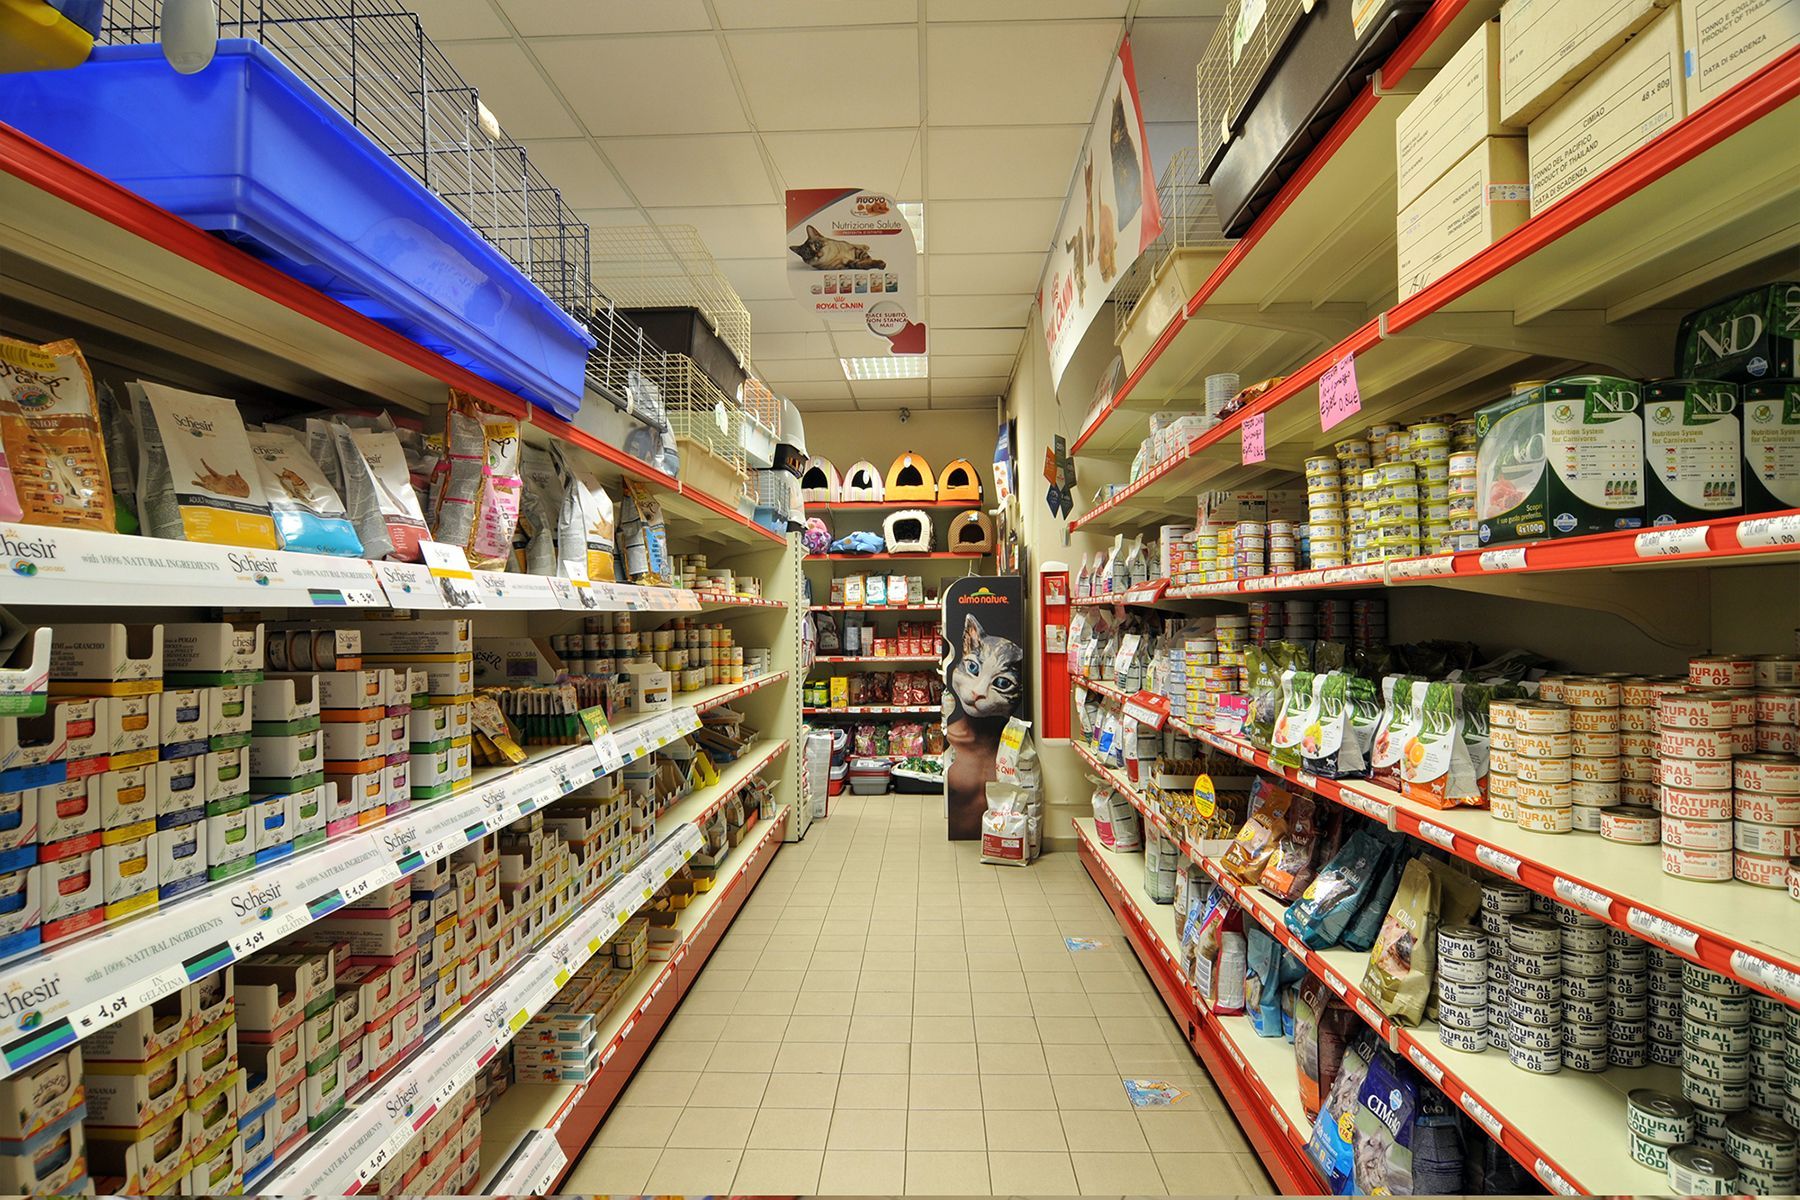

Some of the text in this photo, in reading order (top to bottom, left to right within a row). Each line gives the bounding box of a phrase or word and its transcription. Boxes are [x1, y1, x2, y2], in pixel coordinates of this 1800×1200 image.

[1701, 17, 1724, 36] TONNO
[1701, 14, 1743, 45] PRODUCT OF
[1703, 34, 1767, 76] DATA DI SCADENZA
[1583, 107, 1605, 128] CIMIAO
[1533, 133, 1592, 180] TONNO DEL PACIFICO
[1534, 140, 1599, 190] PRODUCT OF THAILAND
[1534, 166, 1588, 207] DATA DI SCADENZA
[832, 220, 901, 229] Nutrizione Salute
[816, 302, 864, 310] ROYAL CANIN
[1695, 313, 1762, 365] N&D
[1592, 391, 1639, 413] N&D
[1692, 392, 1737, 414] N&D
[172, 413, 214, 432] Schesir
[1552, 428, 1604, 436] Nutrition System
[1526, 504, 1543, 513] Scopri
[1517, 522, 1545, 535] 4x100g
[82, 554, 99, 564] with
[101, 555, 121, 566] 100%
[123, 556, 166, 568] NATURAL
[167, 558, 220, 571] INGREDIENTS
[227, 552, 278, 574] Schesir
[384, 566, 417, 584] Schesir
[481, 574, 506, 589] Schesir
[338, 633, 359, 643] Schesir
[1712, 677, 1730, 685] 02
[1689, 717, 1709, 726] 03
[1539, 748, 1552, 756] 01
[1697, 748, 1716, 758] 03
[1526, 771, 1537, 780] 01
[1674, 776, 1692, 786] 03
[1744, 780, 1762, 790] 03
[1540, 797, 1552, 805] 01
[1668, 793, 1731, 809] NATURAL
[1670, 805, 1709, 817] CODE
[1753, 811, 1774, 822] 03
[1544, 822, 1556, 830] 01
[1667, 834, 1682, 844] 03
[1667, 863, 1681, 873] 03
[84, 970, 103, 983] with
[103, 961, 126, 976] 100%
[125, 940, 170, 965] NATURAL
[169, 917, 224, 947] INGREDIENTS
[231, 880, 281, 918] Schesir
[296, 881, 305, 890] with
[319, 864, 344, 880] NATURAL
[344, 849, 379, 869] INGREDIENTS
[383, 826, 417, 852] Schesir
[481, 788, 506, 808] Schesir
[352, 880, 368, 895] 1,07
[1487, 901, 1499, 910] 08
[285, 914, 294, 922] IN
[1563, 915, 1577, 925] 08
[277, 915, 309, 935] GELATINA
[245, 931, 264, 949] 1,07
[1613, 938, 1628, 947] 08
[1462, 949, 1476, 959] 08
[1526, 965, 1541, 975] 08
[151, 975, 165, 987] IN
[139, 976, 185, 1004] GELATINA
[1618, 986, 1632, 994] 08
[1651, 982, 1666, 991] 08
[1729, 986, 1741, 994] 11
[1444, 993, 1457, 1002] 08
[1536, 992, 1551, 1000] 08
[1570, 990, 1585, 998] 08
[98, 996, 127, 1018] 1,07
[484, 1000, 508, 1028] Schesir
[1609, 1008, 1624, 1017] 08
[1705, 1011, 1718, 1021] 11
[1457, 1018, 1471, 1027] 08
[1534, 1016, 1549, 1024] 08
[1578, 1014, 1593, 1022] 08
[1657, 1030, 1673, 1039] 08
[1462, 1041, 1476, 1051] 08
[1536, 1040, 1551, 1048] 08
[1718, 1043, 1731, 1052] 11
[1527, 1062, 1542, 1071] 08
[1575, 1060, 1590, 1070] 08
[1707, 1069, 1720, 1079] 11
[386, 1079, 419, 1119] Schesir
[1707, 1098, 1721, 1108] 11
[348, 1121, 383, 1156] INGREDIENTS
[1674, 1134, 1686, 1142] 11
[369, 1149, 387, 1169] 1,07
[1759, 1158, 1773, 1169] 11
[322, 1153, 349, 1180] NATURAL
